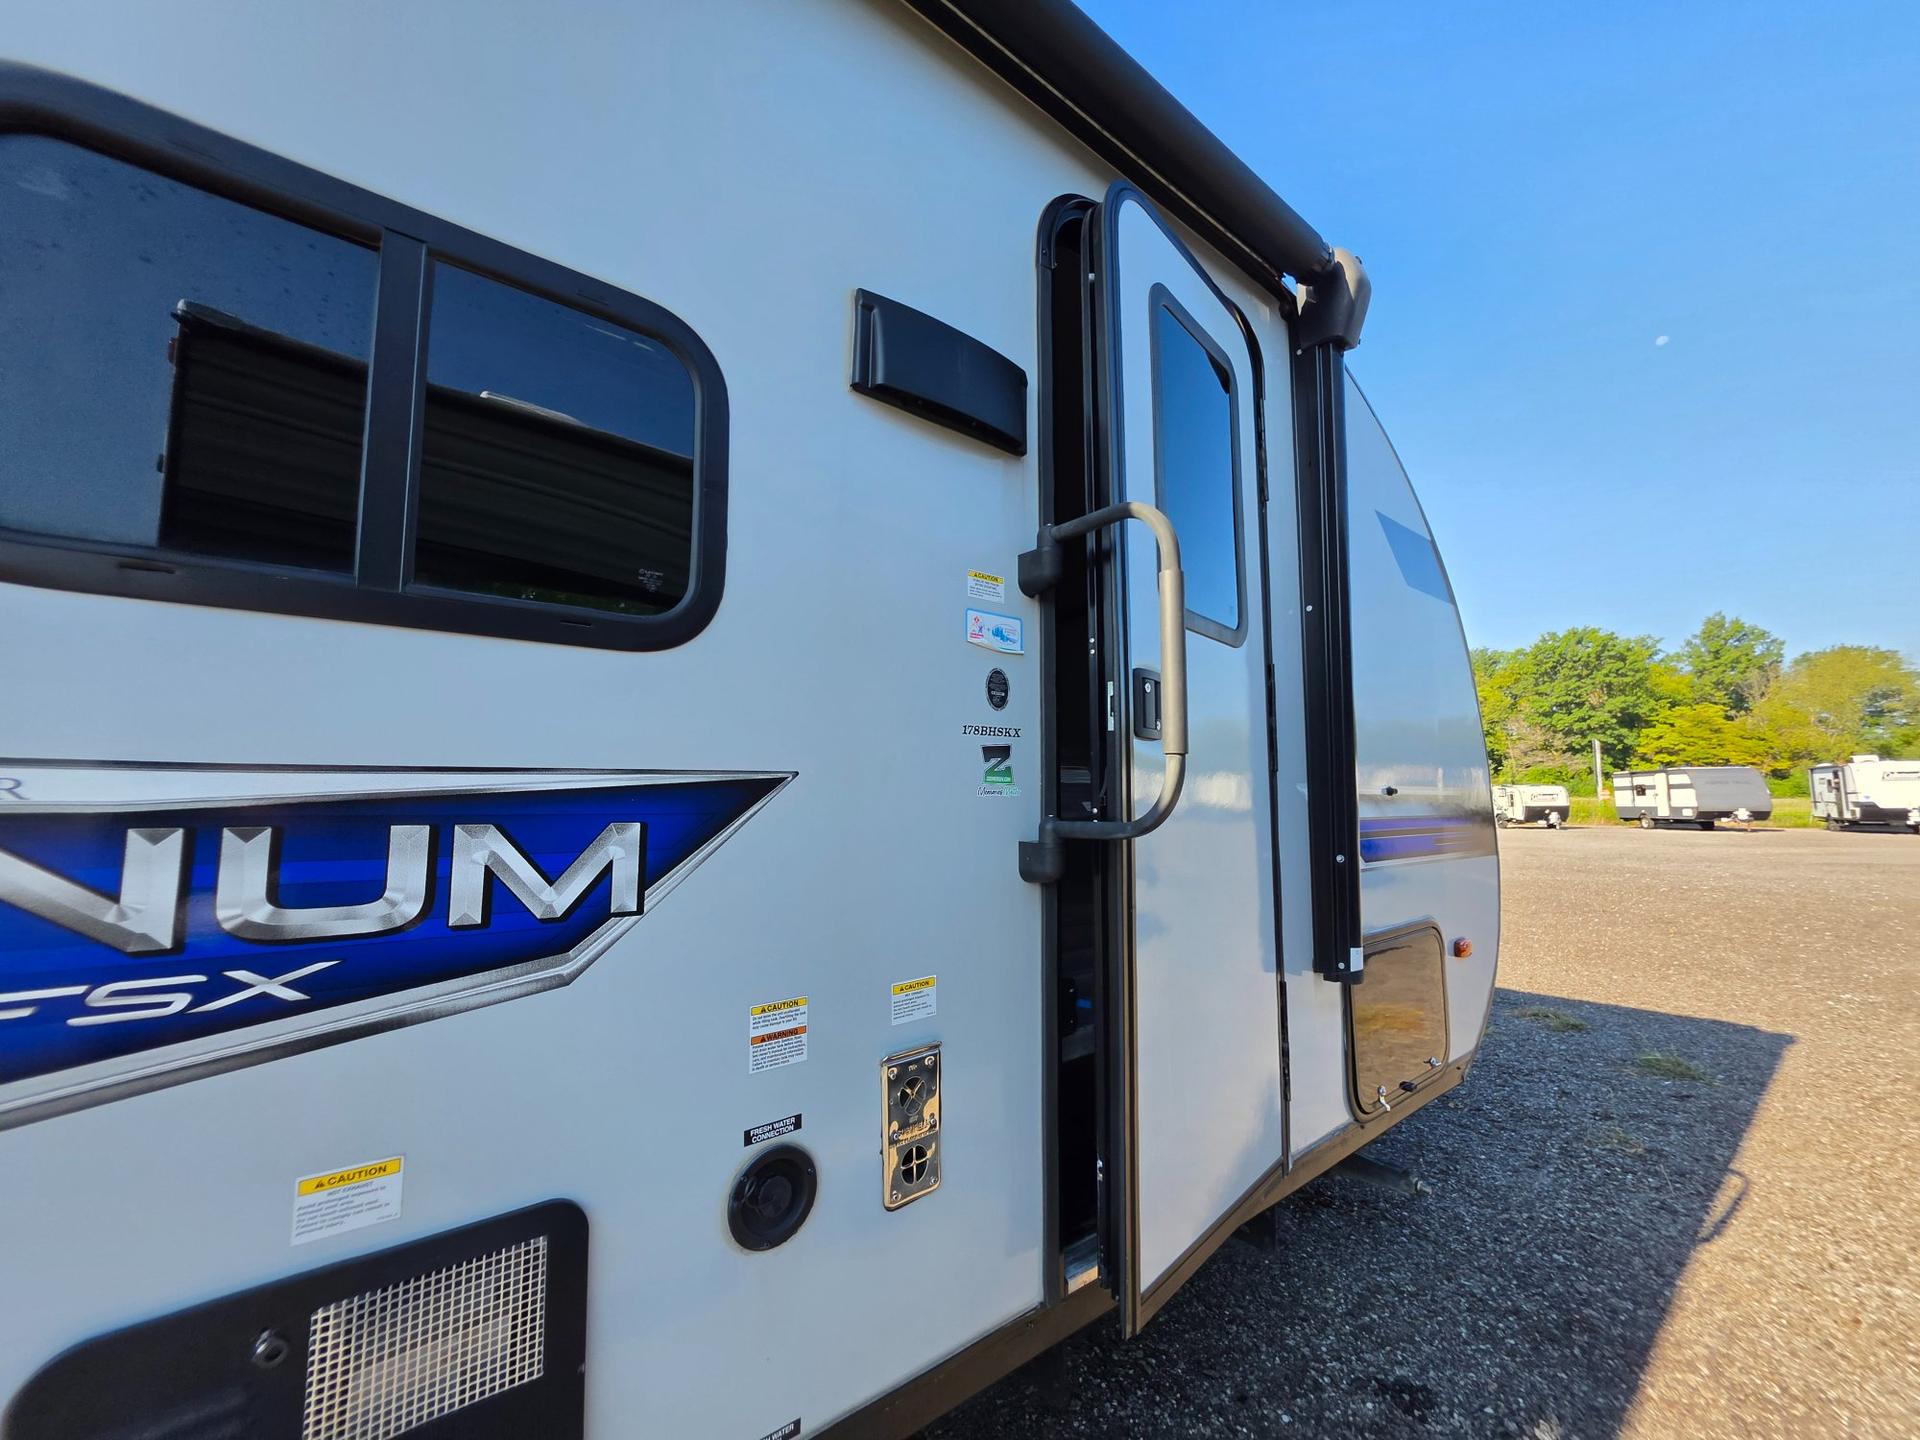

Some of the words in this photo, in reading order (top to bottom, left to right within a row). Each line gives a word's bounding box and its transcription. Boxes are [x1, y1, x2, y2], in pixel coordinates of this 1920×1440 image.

[978, 573, 999, 583] CAUTION
[962, 725, 1021, 738] 178BHSKX
[905, 980, 930, 991] CAUTION
[767, 1000, 799, 1012] CAUTION
[766, 1028, 799, 1041] WARNING
[750, 1123, 772, 1137] FRESH
[773, 1117, 795, 1130] WATER
[751, 1124, 794, 1143] CONNECTION
[327, 1164, 388, 1186] CAUTION
[772, 1423, 794, 1440] WATER
